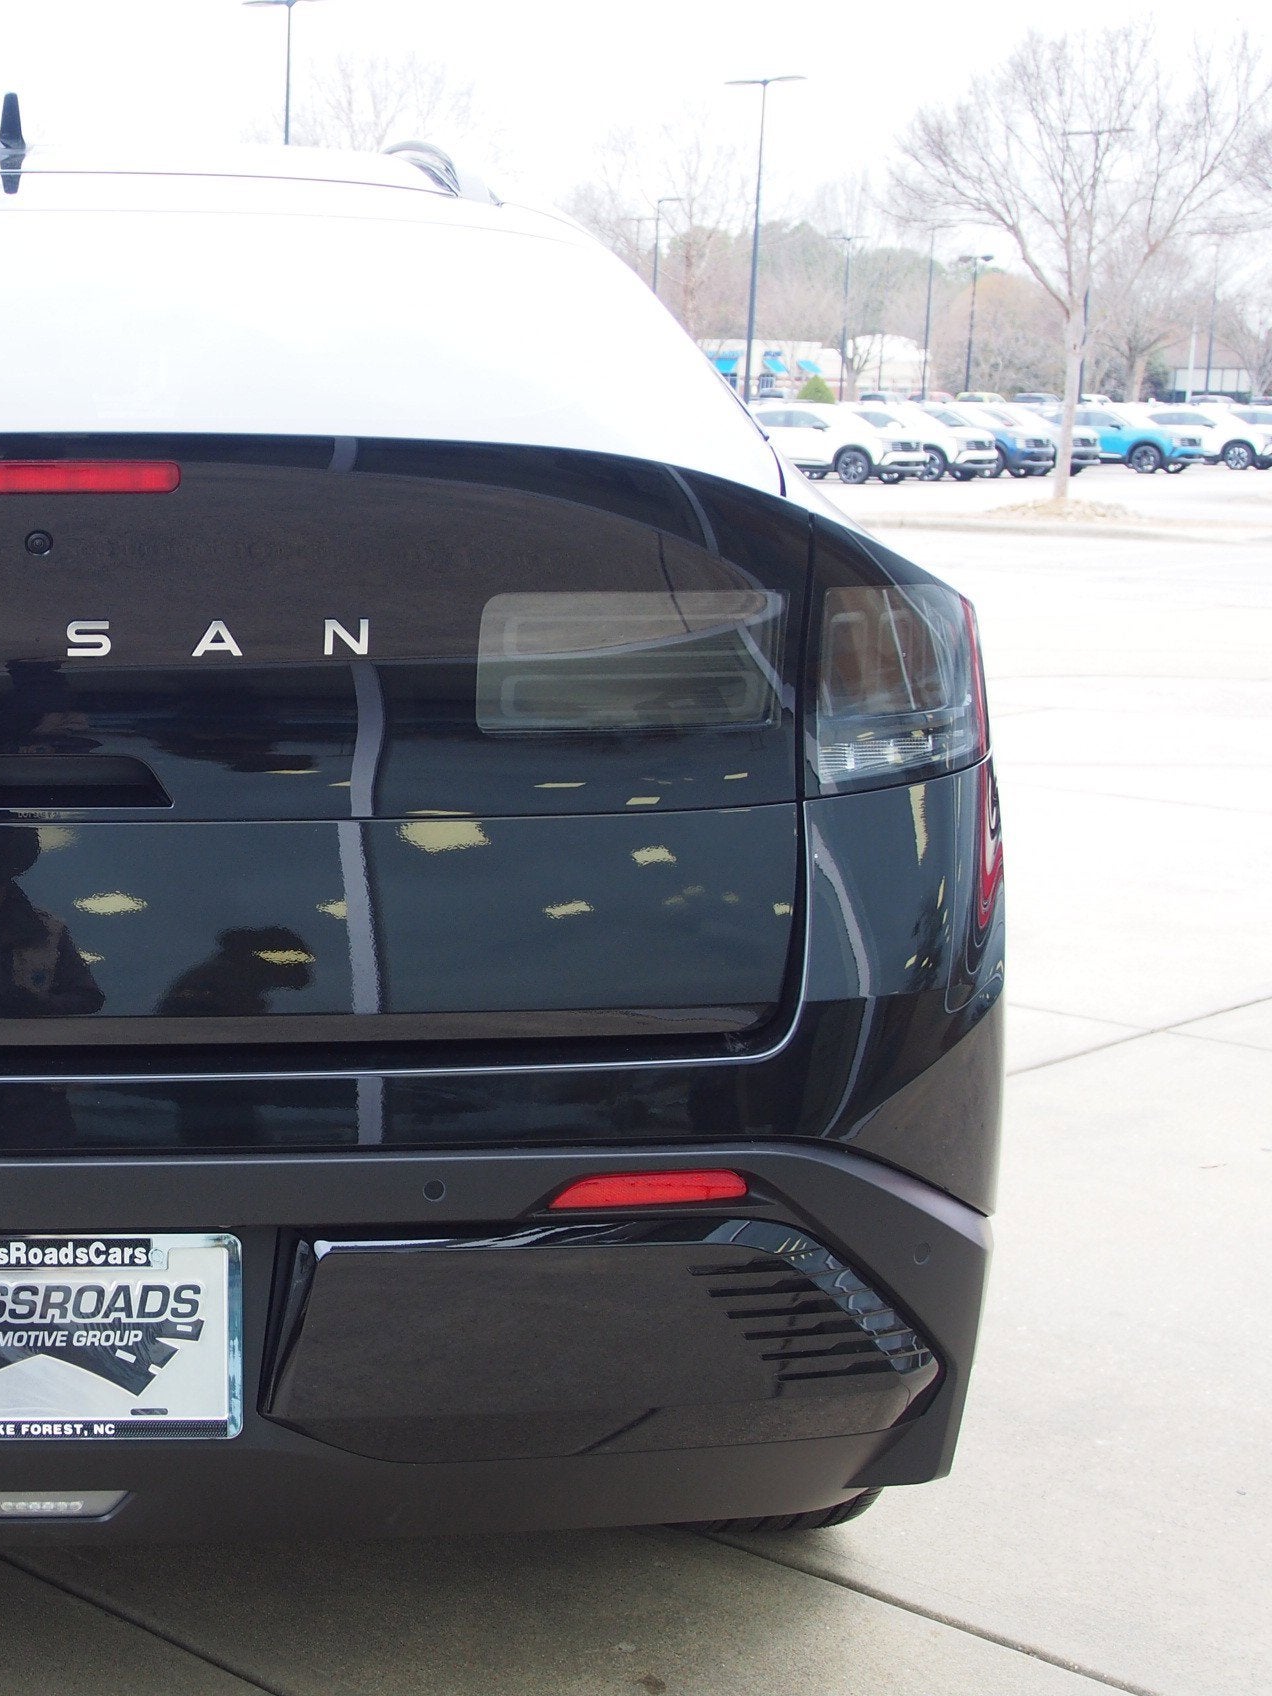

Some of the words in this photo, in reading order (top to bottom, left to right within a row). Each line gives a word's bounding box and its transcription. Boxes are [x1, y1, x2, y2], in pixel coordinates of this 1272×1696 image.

[77, 1331, 143, 1347] GROUP
[21, 1424, 88, 1437] FOREST,
[93, 1424, 116, 1436] NC
